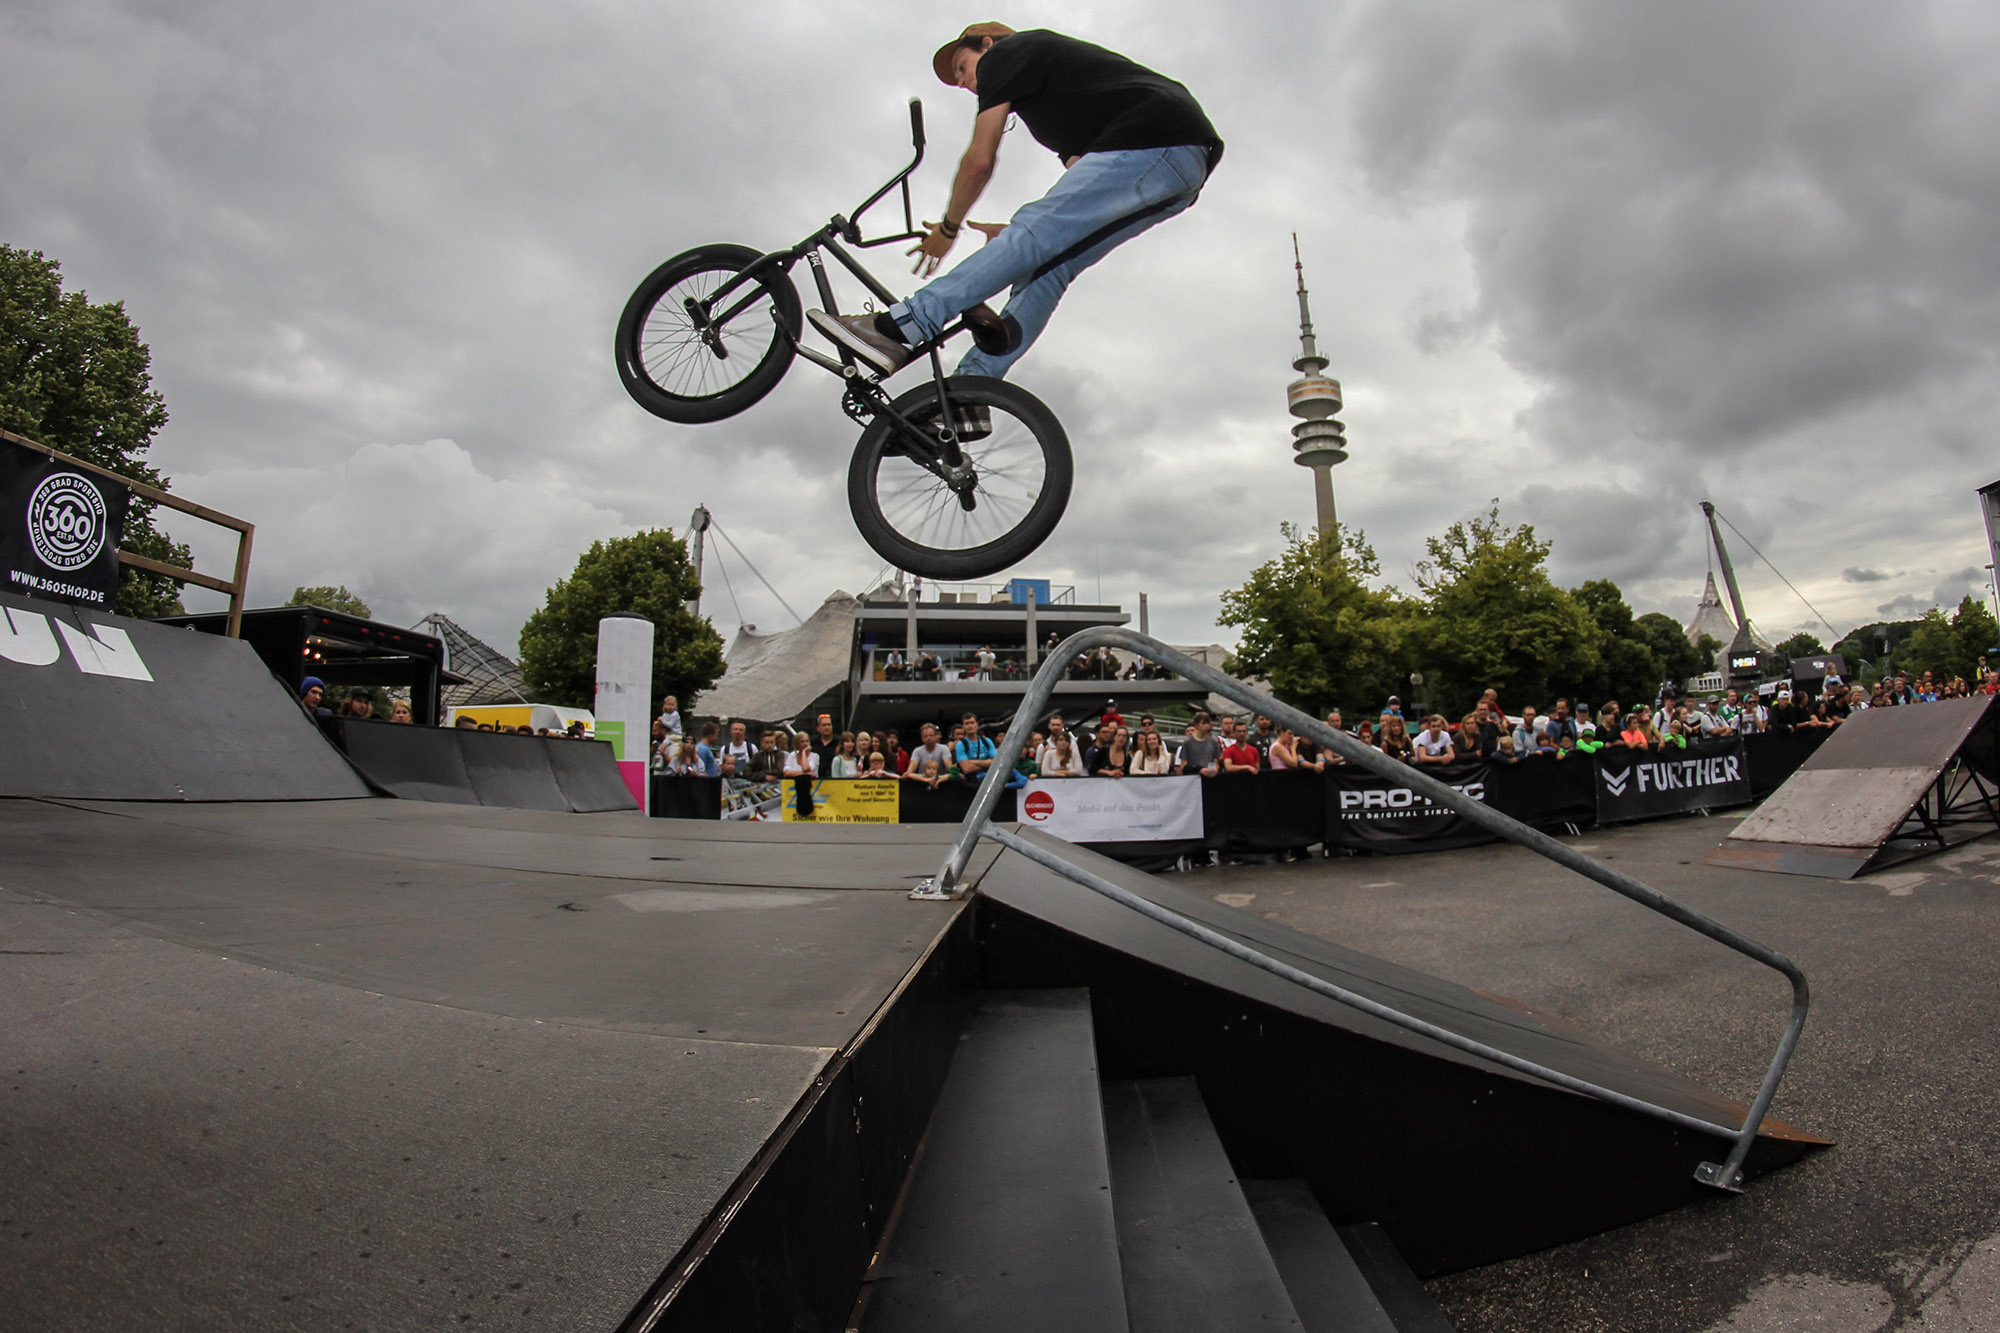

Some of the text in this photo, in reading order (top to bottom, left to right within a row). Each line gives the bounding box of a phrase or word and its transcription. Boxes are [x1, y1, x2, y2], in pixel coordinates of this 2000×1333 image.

[38, 486, 51, 502] 360
[50, 478, 72, 490] GRAD
[44, 504, 92, 540] 360
[33, 521, 99, 566] 360 GRAD SPORTSHOP
[10, 570, 105, 603] WWW.360SHOP.DE
[1636, 755, 1741, 793] FURTHER
[1078, 802, 1102, 813] Mobil
[1119, 802, 1134, 812] den
[1340, 783, 1485, 809] PRO-C
[836, 814, 851, 822] Ihre
[852, 814, 890, 824] Wohnung
[1366, 810, 1418, 819] ORIGINAL
[1424, 808, 1456, 816] SINC
